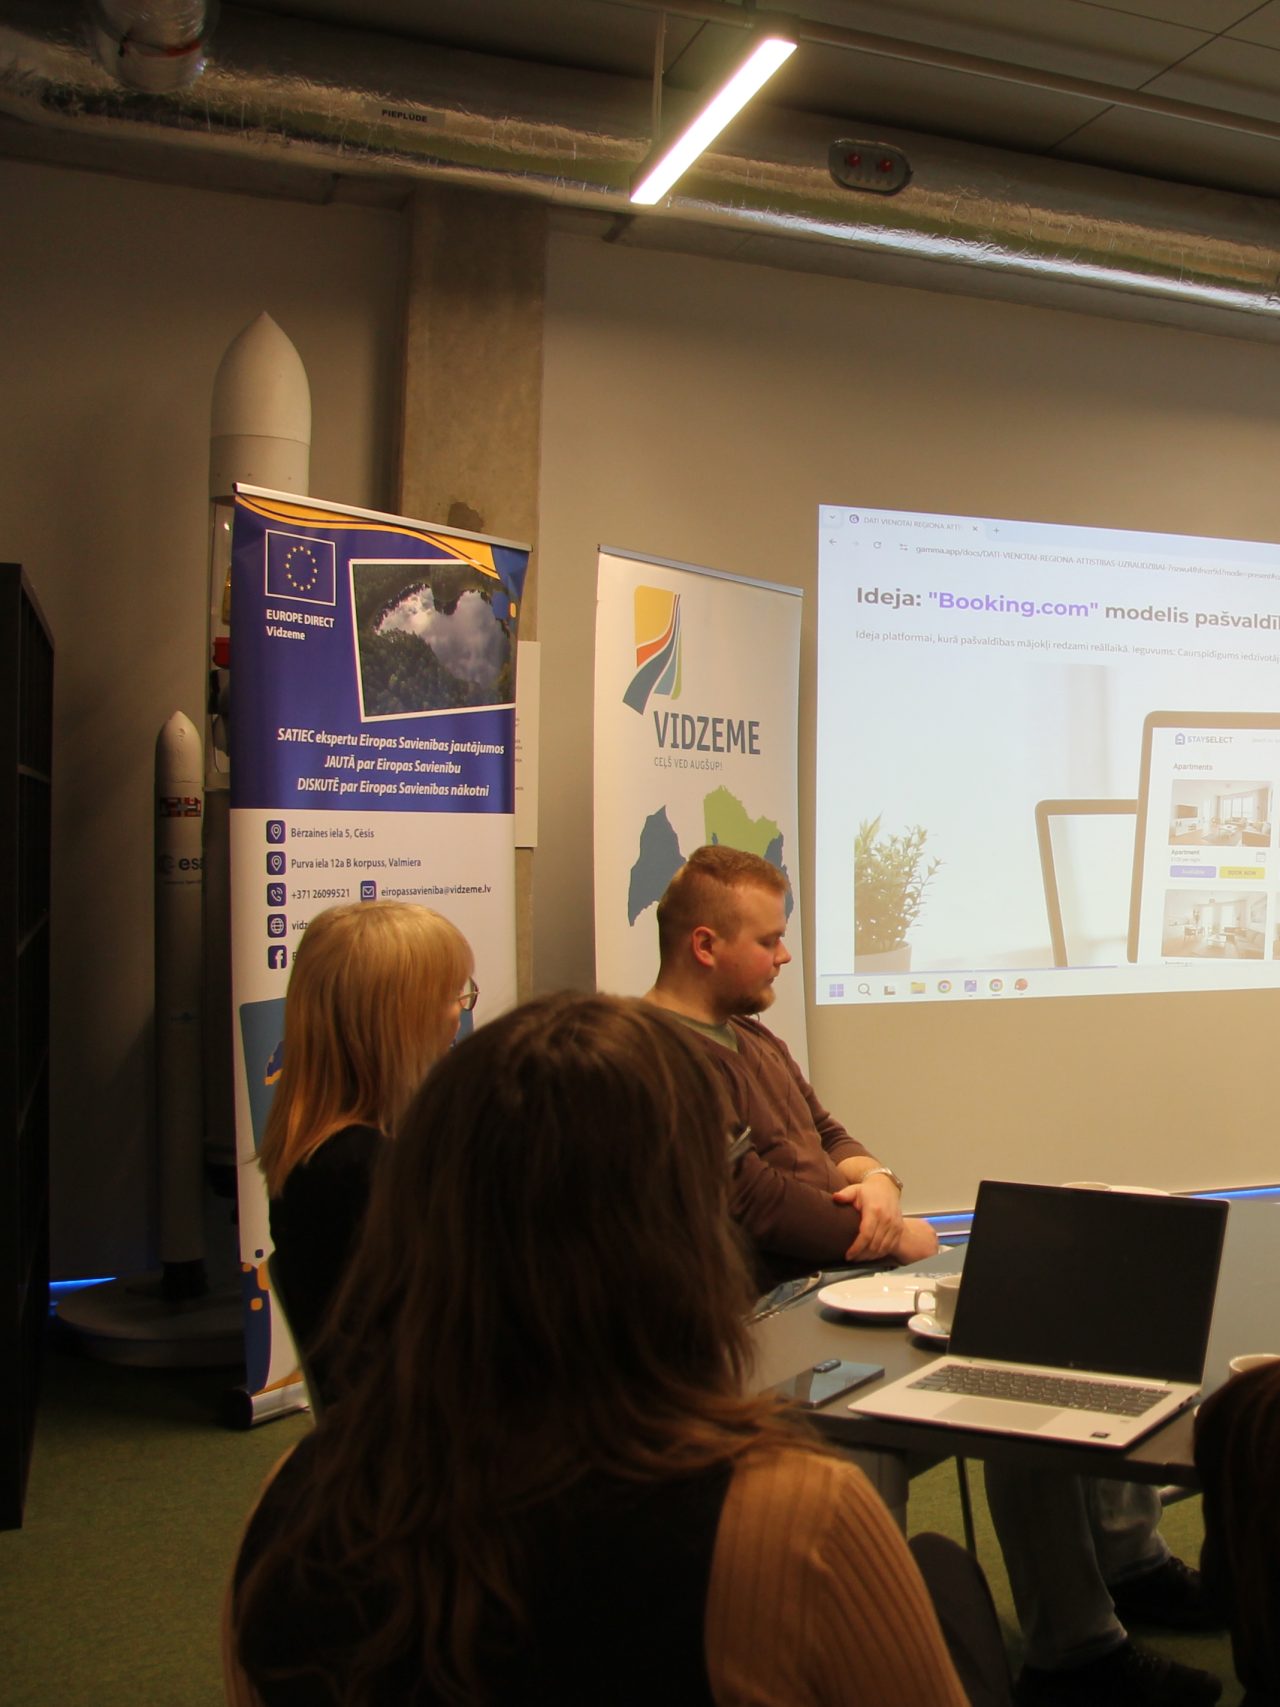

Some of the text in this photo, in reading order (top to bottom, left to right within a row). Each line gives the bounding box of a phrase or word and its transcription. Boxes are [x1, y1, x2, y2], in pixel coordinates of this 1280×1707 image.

[856, 586, 922, 610] Ideja:
[928, 591, 1099, 618] "Booking.com"
[1105, 605, 1189, 624] modelis
[266, 609, 335, 629] EUROPE DIRECT
[266, 625, 306, 641] Vidzeme
[855, 630, 880, 641] Ideja
[881, 631, 936, 645] platformai,
[937, 633, 959, 645] kurā
[1052, 640, 1089, 652] redzami
[277, 728, 505, 756] SATIEC ekspertu Eiropas Savienības jautājumos
[654, 711, 760, 754] VIDZEME
[324, 754, 461, 774] JAUTĀ par Eiropas Savienību
[674, 758, 689, 769] VED
[1173, 762, 1214, 772] Apartments
[297, 776, 489, 797] DISKUTĒ par Eiropas Savienības nākotni
[291, 827, 375, 840] Bērzaines iela 5, Cēsis
[291, 857, 422, 870] Purva iela 12a B korpuss, Valmiera
[291, 888, 350, 900] +371 26099521
